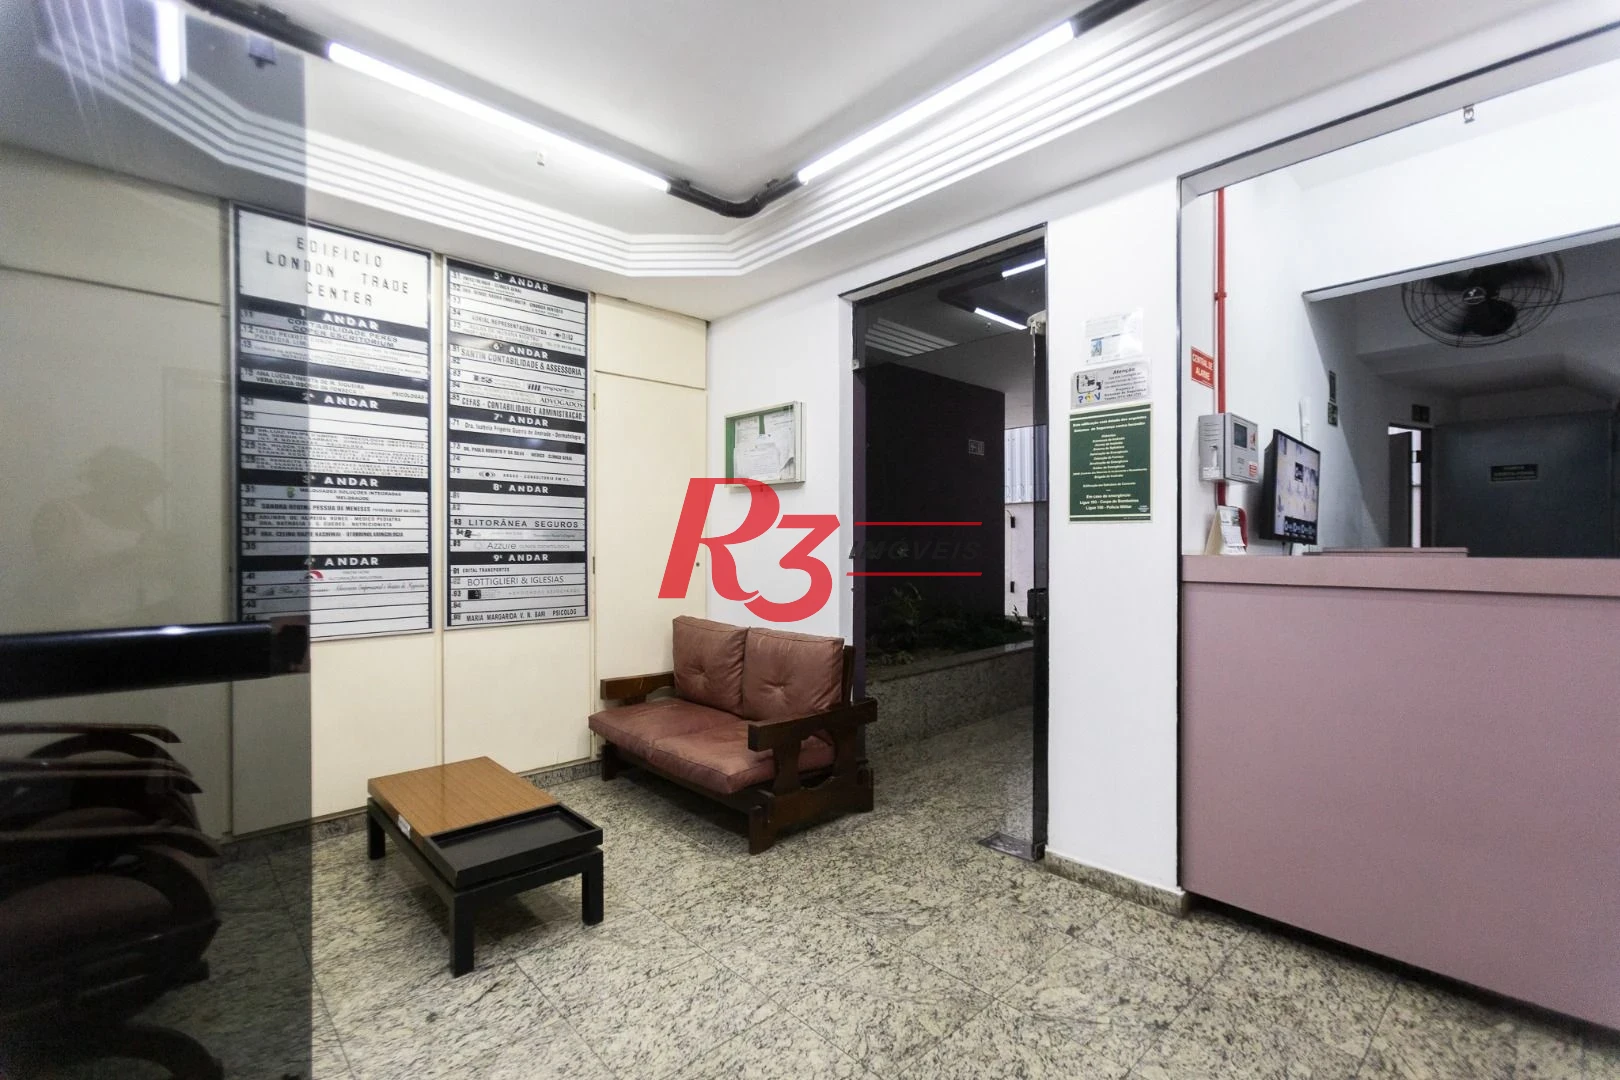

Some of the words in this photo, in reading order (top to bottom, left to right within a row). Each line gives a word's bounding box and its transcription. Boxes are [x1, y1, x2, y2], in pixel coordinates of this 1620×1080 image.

[265, 251, 335, 277] LONDON
[361, 273, 409, 294] TRADE
[509, 276, 549, 292] ANDAR
[305, 282, 373, 306] CENTER
[322, 312, 380, 330] ANDAR
[509, 346, 549, 360] ANDAR
[324, 396, 379, 410] ANDAR
[540, 397, 583, 408] ADVOGADOS
[509, 415, 549, 426] ANDAR
[324, 477, 379, 487] ANDAR
[509, 484, 549, 493] ANDAR
[468, 518, 527, 527] LITORÂNEA
[534, 520, 579, 528] SEGUROS
[487, 542, 516, 550] Azzure
[324, 557, 379, 566] ANDAR
[508, 554, 549, 562] ANDAR
[467, 577, 519, 586] BOTTIGLIERI
[530, 575, 564, 584] IGLESIAS
